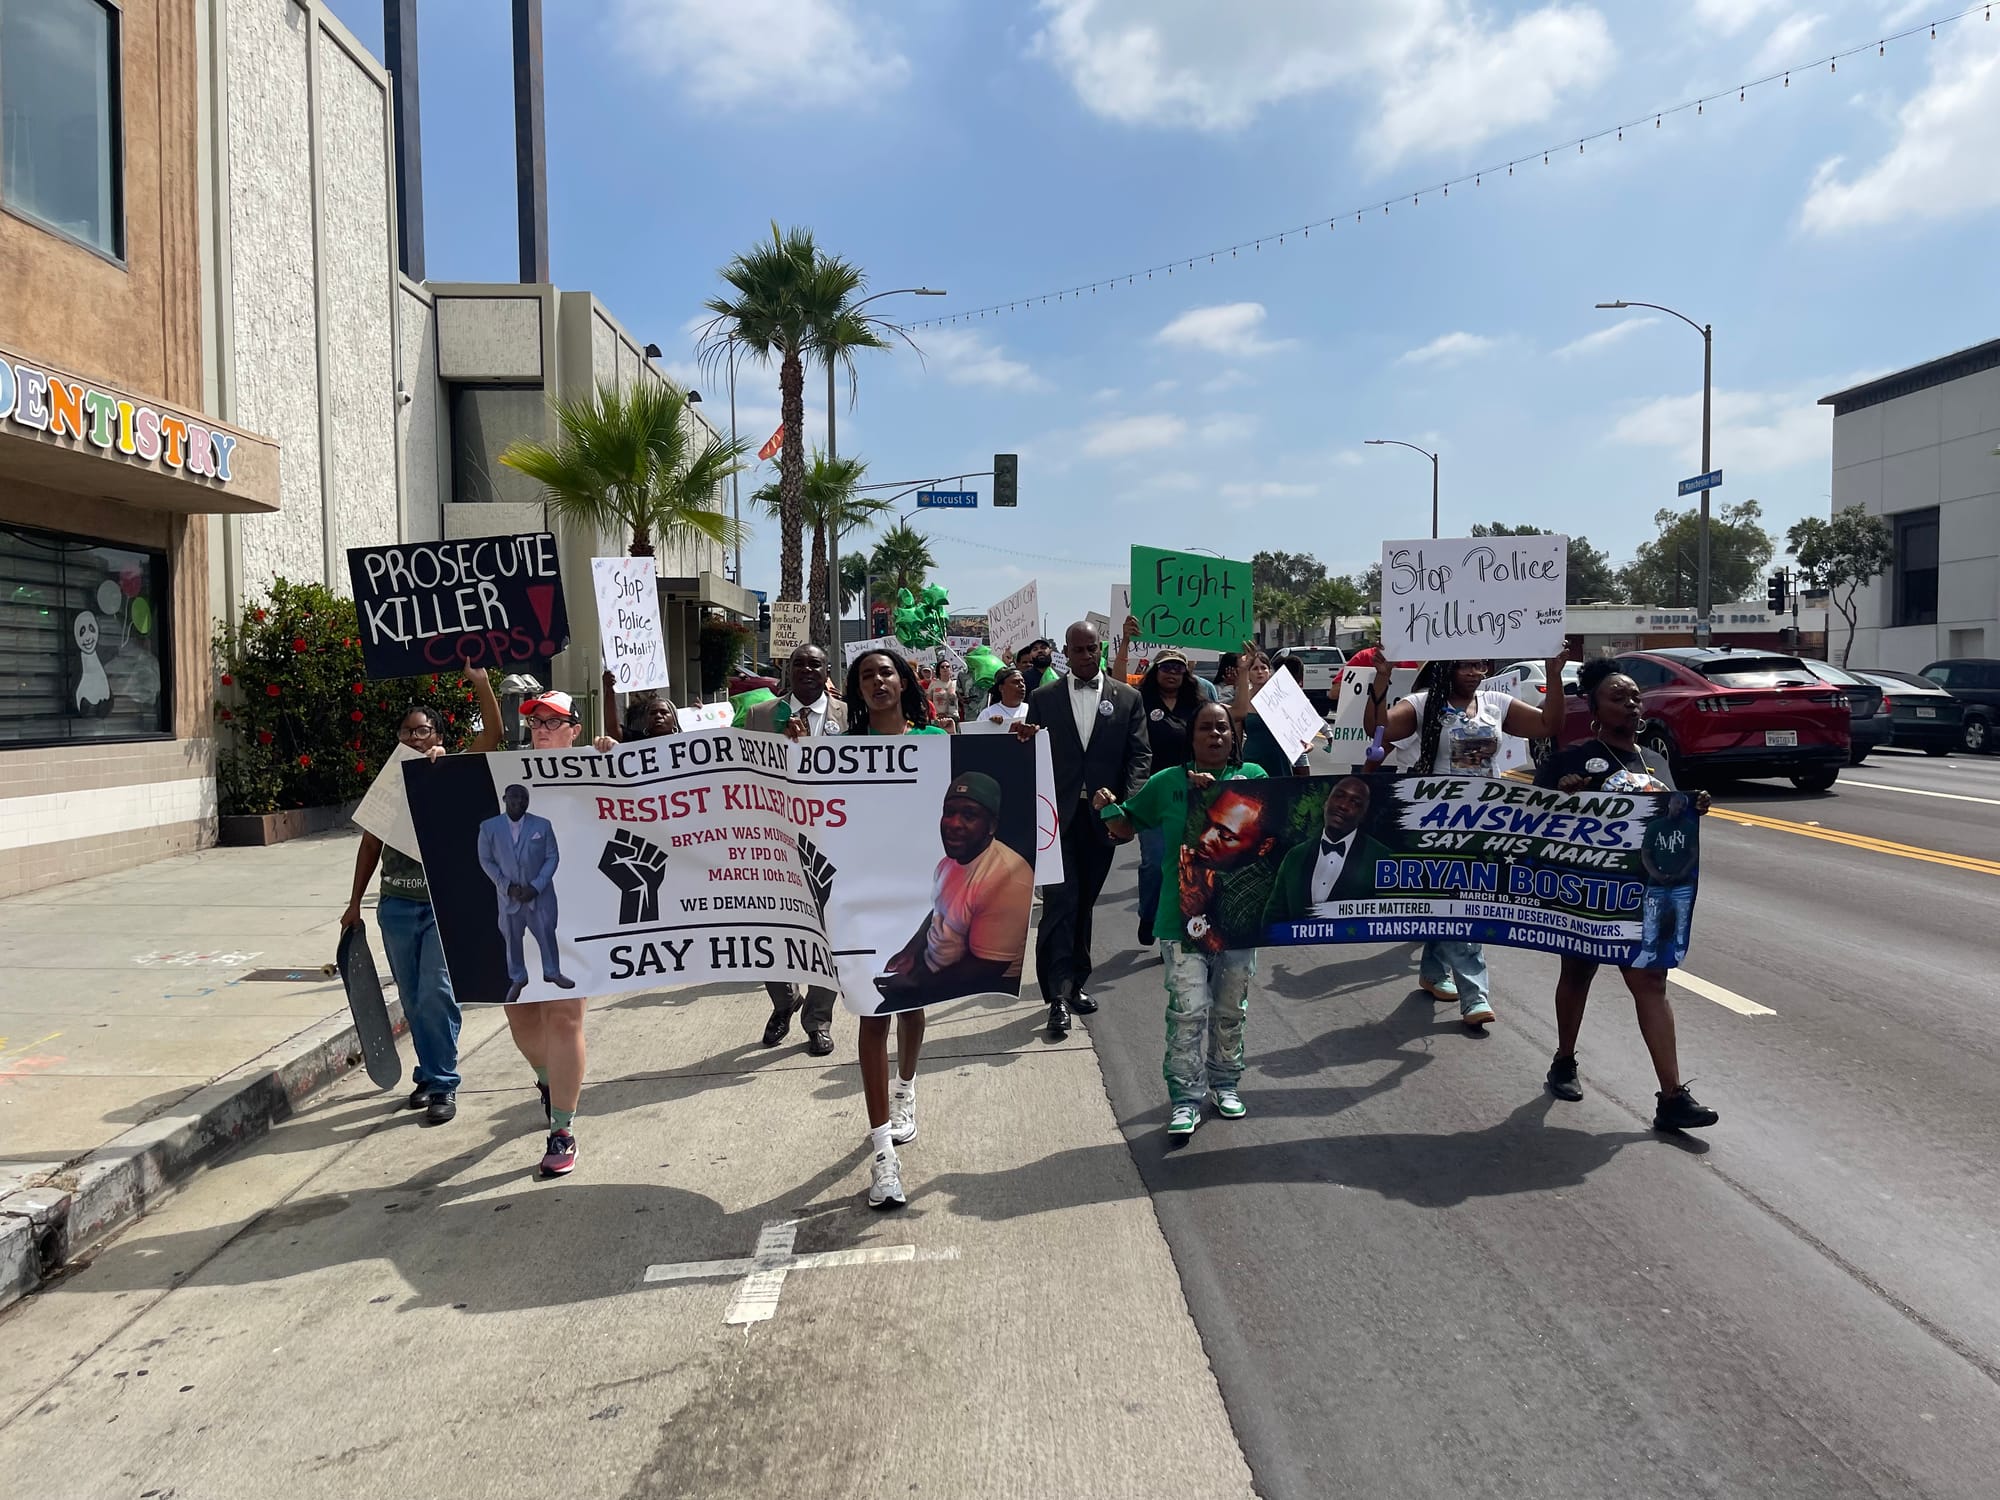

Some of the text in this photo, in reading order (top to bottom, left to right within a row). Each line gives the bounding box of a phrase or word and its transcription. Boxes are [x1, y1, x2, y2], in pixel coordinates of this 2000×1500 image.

[932, 495, 975, 504] Locust St
[364, 534, 557, 595] PROSECUTE
[614, 571, 644, 603] Stop
[1155, 556, 1236, 607] Fight
[364, 581, 510, 646] KILLER
[618, 608, 653, 631] Police
[793, 603, 807, 614] FOR
[1142, 588, 1248, 641] Back!
[1650, 614, 1725, 625] INSURACE
[614, 635, 657, 663] Brutality
[775, 631, 798, 640] POLICE
[1334, 727, 1372, 741] BRYA
[521, 736, 919, 780] JUSTICE FOR BRYAN BOSTIC
[595, 783, 848, 828] RESIST KILLER COPS
[1413, 779, 1635, 819] WE DEMAND
[671, 827, 728, 848] BRYAN
[732, 826, 761, 840] WAS
[1419, 802, 1633, 848] ANSWERS.
[728, 847, 788, 862] BY IPD ON
[1417, 832, 1629, 870] SAY HIS NAME.
[708, 868, 760, 881] MARCH
[763, 868, 785, 882] 10th
[1375, 859, 1499, 893] BRYAN
[1508, 864, 1645, 912] BOSTIC
[680, 897, 708, 912] WE
[713, 896, 776, 910] DEMAND
[1338, 901, 1434, 916] HIS LIFE MATTERED.
[1459, 891, 1541, 907] MARCH 10, 2026
[1465, 904, 1625, 938] HIS DEATH DESERVES ANSWERS.
[1291, 922, 1631, 959] TRUTH TRANSPARENCY ACCOUNTABILITY
[610, 938, 694, 979] SAY
[709, 936, 775, 969] HIS
